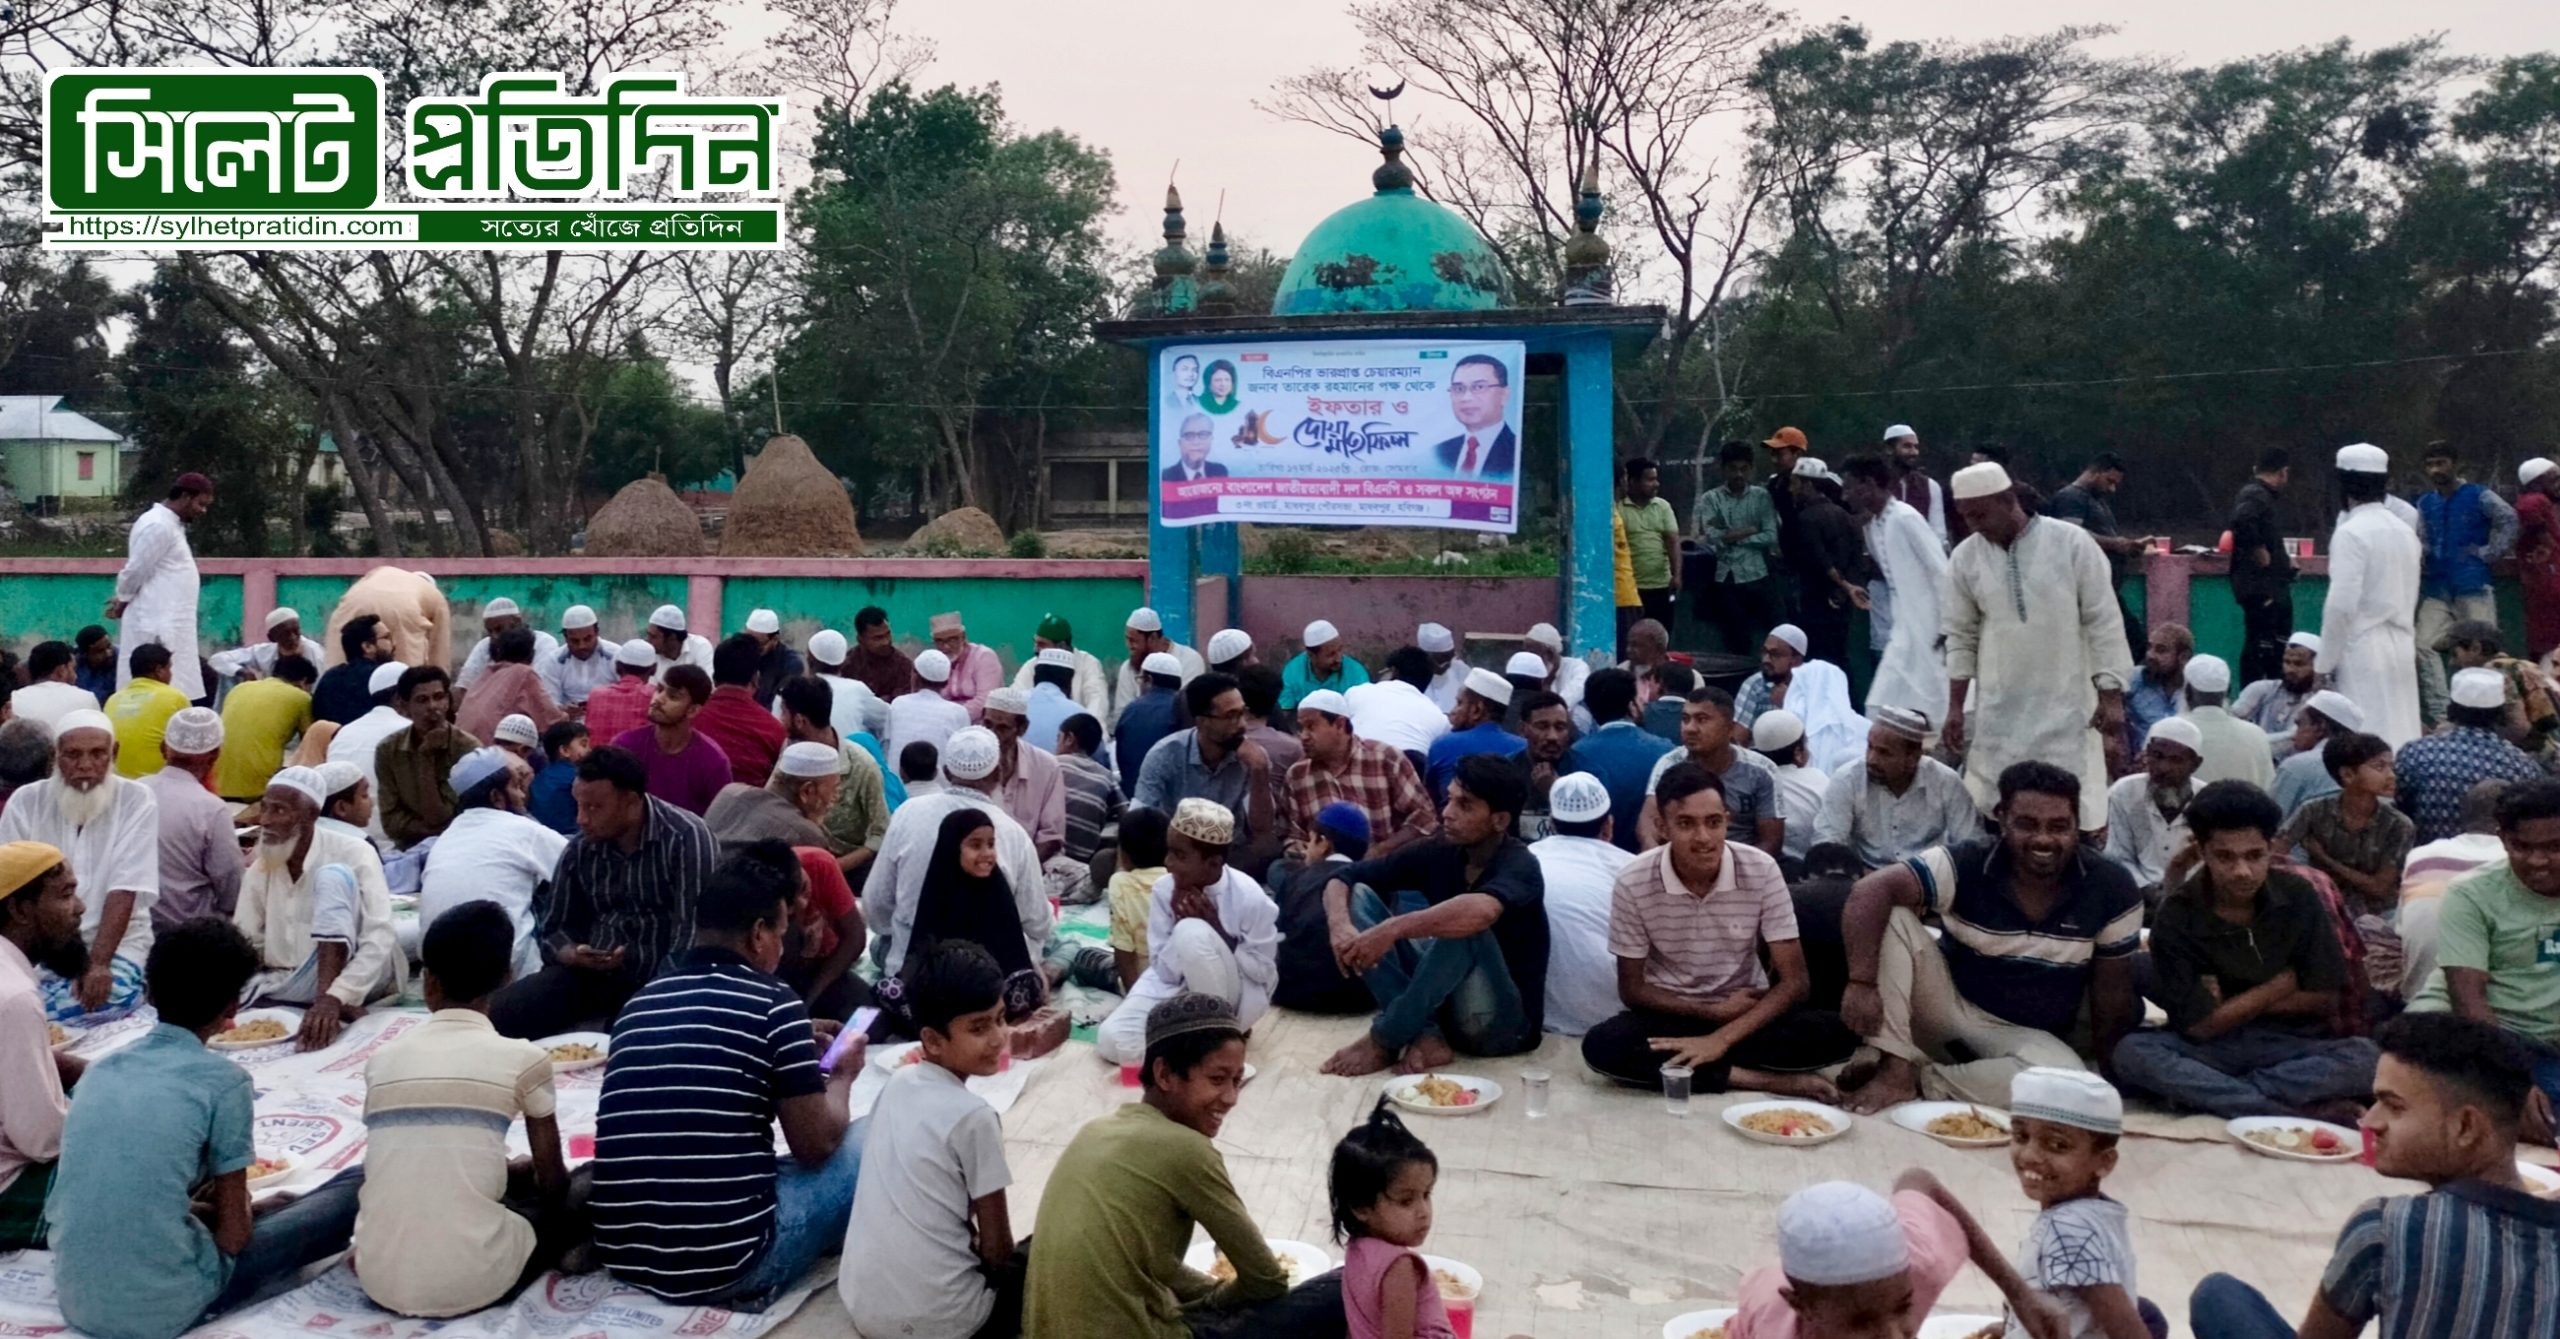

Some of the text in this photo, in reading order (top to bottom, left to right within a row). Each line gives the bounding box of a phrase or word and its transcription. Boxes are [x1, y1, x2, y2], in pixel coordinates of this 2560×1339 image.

[1263, 365, 1422, 379] বিএনপির ভারপ্রাপ্ত চেয়ারম্যান
[1248, 381, 1436, 393] জনাব তারেক রহমানের পক্ষ থেকে
[1307, 396, 1409, 416] ইফতার ও
[1293, 416, 1350, 448] দোয়া
[1324, 422, 1419, 462] মাহফিল
[1225, 482, 1273, 494] বাংলাদেশ
[1363, 480, 1401, 496] বিএনপি
